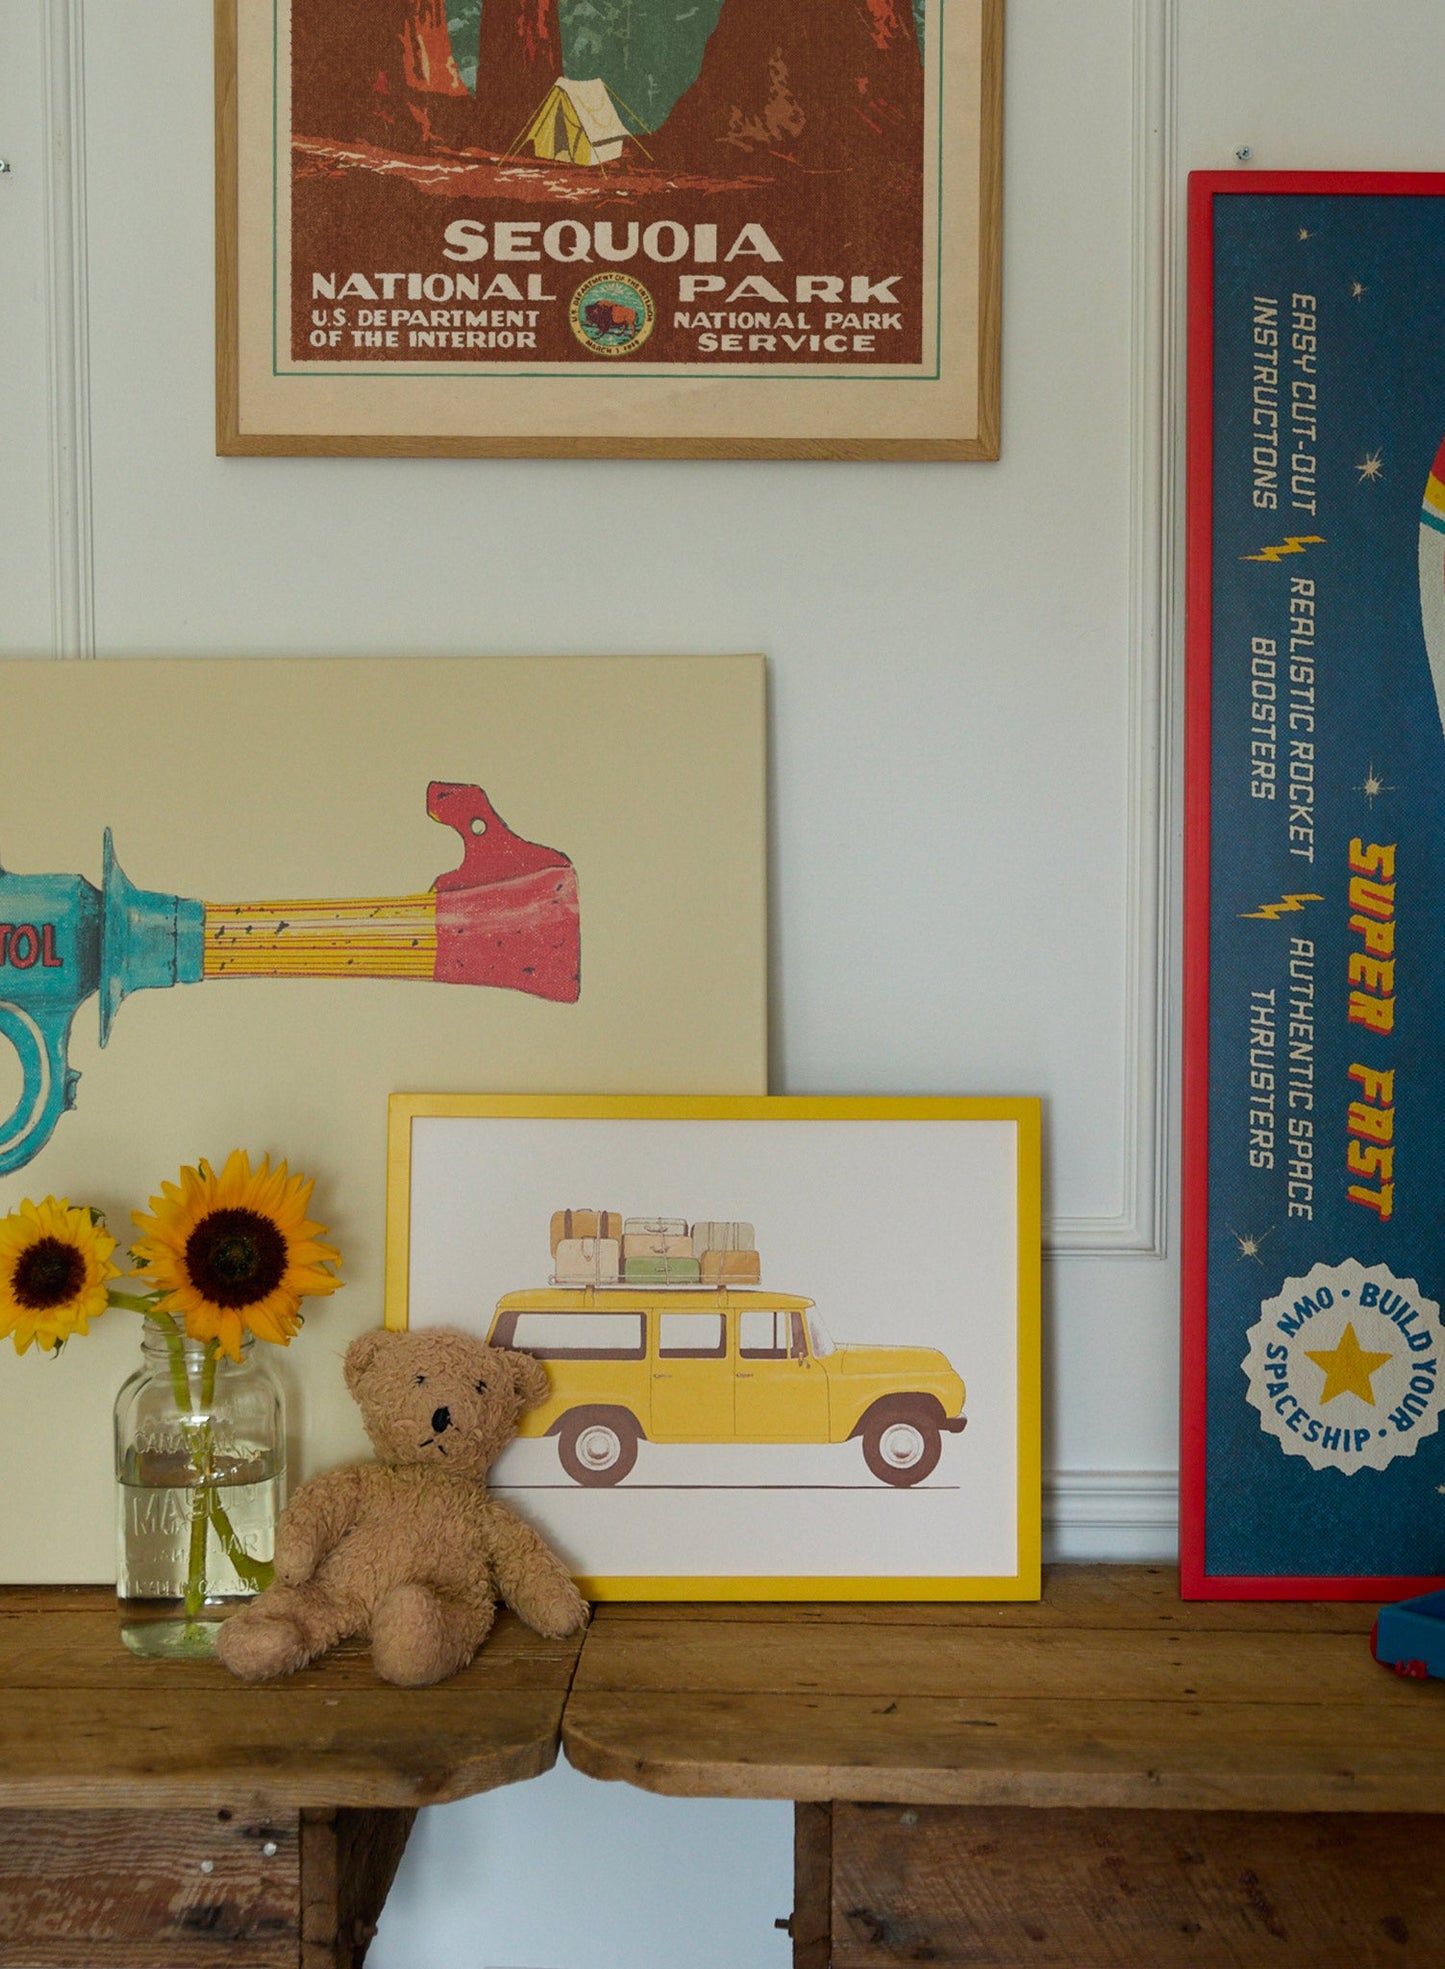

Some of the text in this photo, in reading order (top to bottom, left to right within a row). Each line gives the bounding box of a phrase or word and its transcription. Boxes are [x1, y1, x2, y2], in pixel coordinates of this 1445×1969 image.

[312, 272, 557, 302] NATIONAL
[312, 308, 540, 328] U.S. DEPARTMENT
[442, 219, 783, 263] SEQUOIA
[678, 275, 903, 304] PARK
[309, 330, 537, 349] OF THE INTERIOR
[673, 311, 903, 331] NATIONAL PARK
[698, 333, 876, 353] SERVICE
[1252, 296, 1278, 510] INSTRUCTONS
[1291, 293, 1317, 516] EASY CUT-OUT
[1250, 637, 1276, 800] BOOSTERS
[1288, 577, 1315, 863] REALISTIC ROCKET
[1249, 989, 1276, 1170] THRUSTERS
[1287, 937, 1315, 1221] AUTHENTIC SPACE
[1346, 838, 1397, 1222] SUPER FAST
[1264, 1286, 1372, 1453] OWN SPACESHIP
[1359, 1282, 1438, 1433] BUILD YOUR
